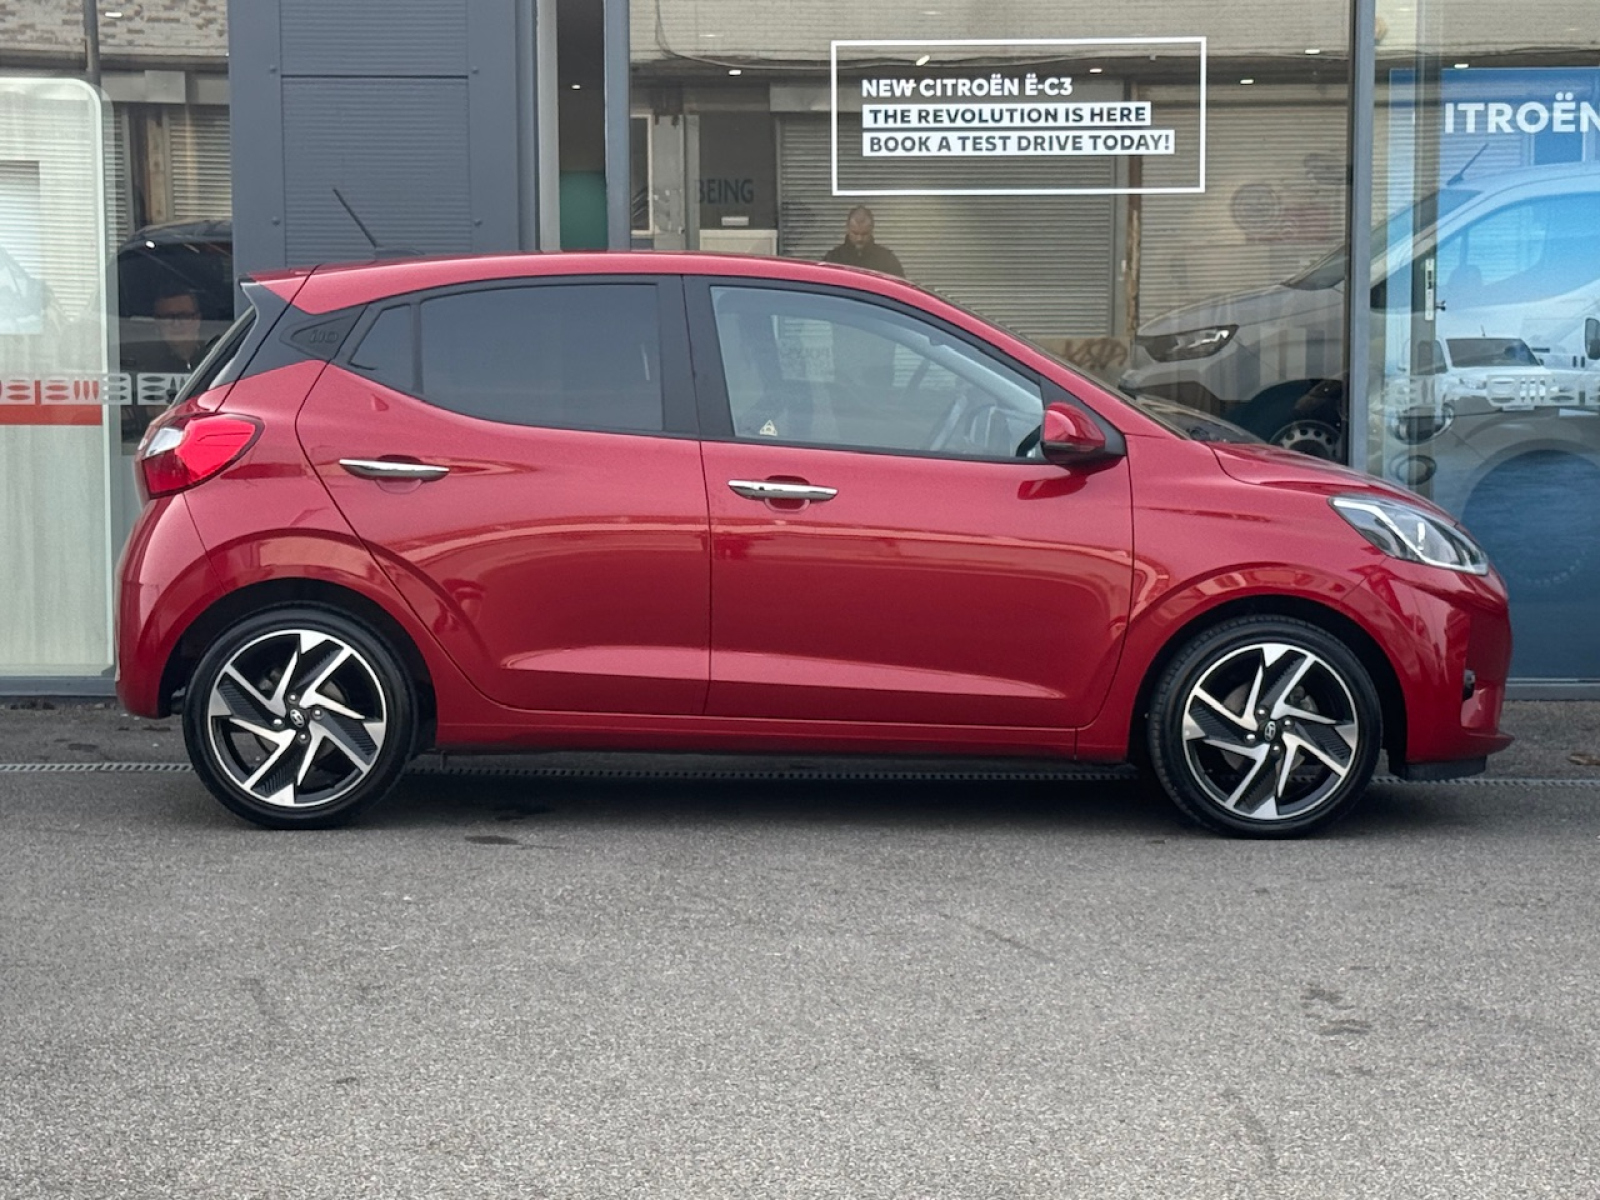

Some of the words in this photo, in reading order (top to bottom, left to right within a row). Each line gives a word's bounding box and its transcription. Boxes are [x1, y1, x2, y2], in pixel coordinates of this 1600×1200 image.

[861, 78, 916, 97] NEW
[919, 73, 1019, 97] CITROËN
[1024, 73, 1073, 96] Ë-C3
[869, 108, 911, 124] THE
[917, 107, 1058, 124] REVOLUTION
[1064, 107, 1084, 123] IS
[1090, 106, 1146, 123] HERE
[1443, 91, 1600, 134] ITROËN
[869, 135, 932, 153] BOOK
[937, 135, 952, 152] A
[957, 135, 1011, 152] TEST
[1017, 134, 1083, 152] DRIVE
[1088, 134, 1170, 151] TODAY!
